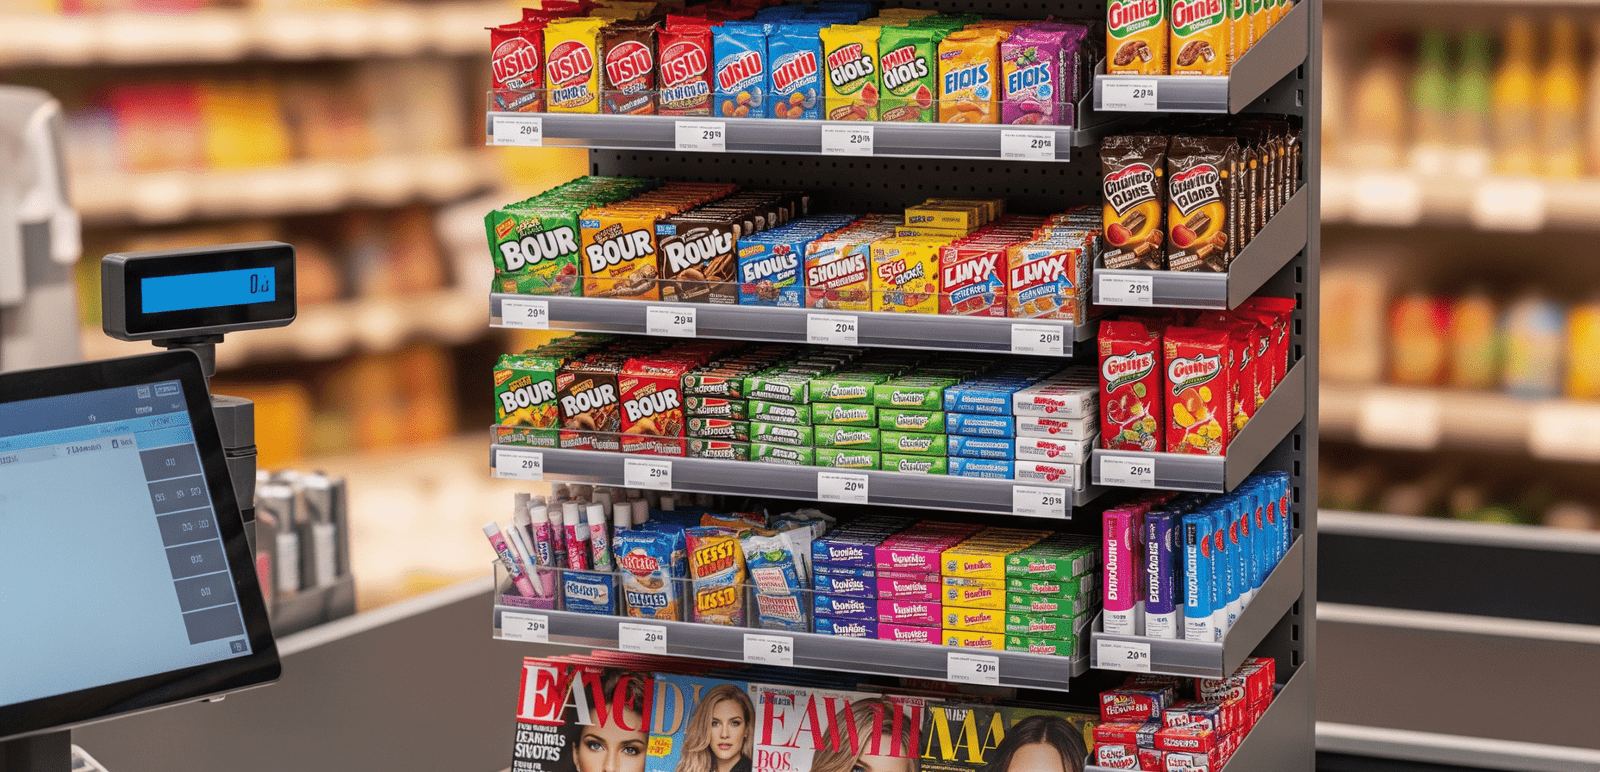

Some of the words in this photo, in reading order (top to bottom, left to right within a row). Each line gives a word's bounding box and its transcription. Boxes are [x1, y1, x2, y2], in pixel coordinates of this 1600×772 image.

[500, 226, 578, 271] BOUR
[586, 229, 655, 273] BOUR
[499, 380, 557, 414] BOUR
[623, 388, 681, 423] BOUR
[522, 460, 534, 469] 29
